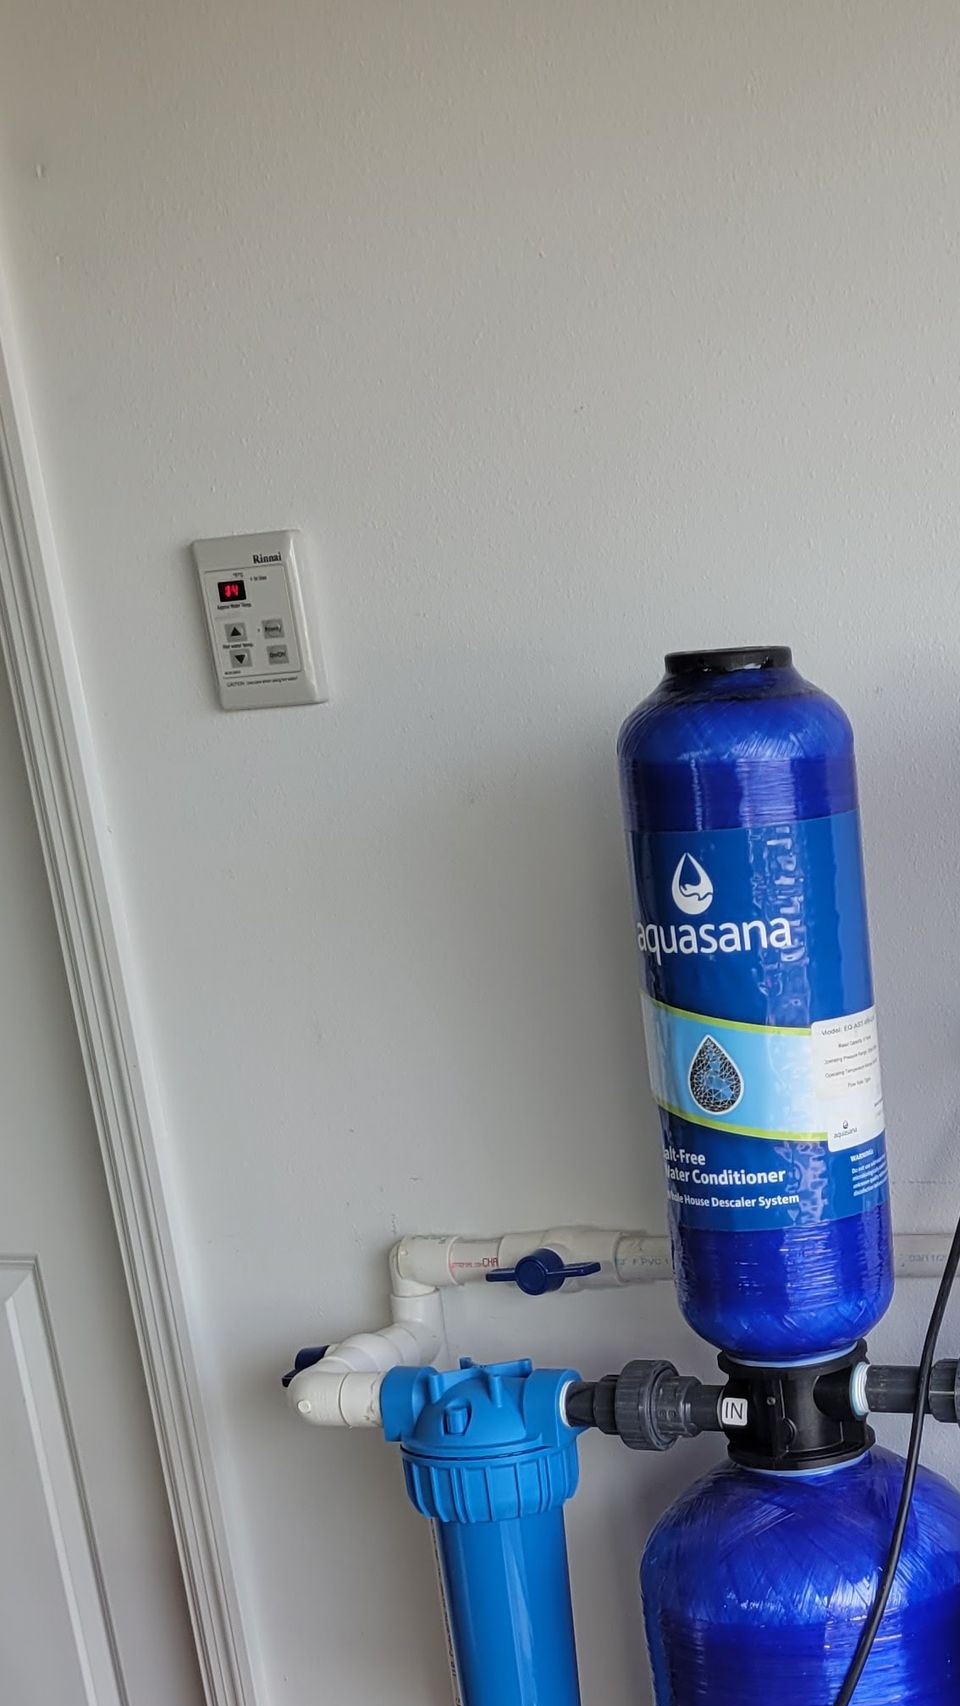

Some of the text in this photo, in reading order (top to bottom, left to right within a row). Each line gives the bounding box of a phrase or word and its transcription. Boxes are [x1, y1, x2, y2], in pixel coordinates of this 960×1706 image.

[252, 552, 282, 565] Rinnai
[637, 916, 792, 966] aquasana
[663, 1143, 706, 1166] alt-Free
[692, 1169, 786, 1186] Conditioner
[684, 1195, 710, 1208] House
[711, 1197, 757, 1208] Descaler
[758, 1194, 800, 1210] System
[725, 1401, 743, 1420] IN
